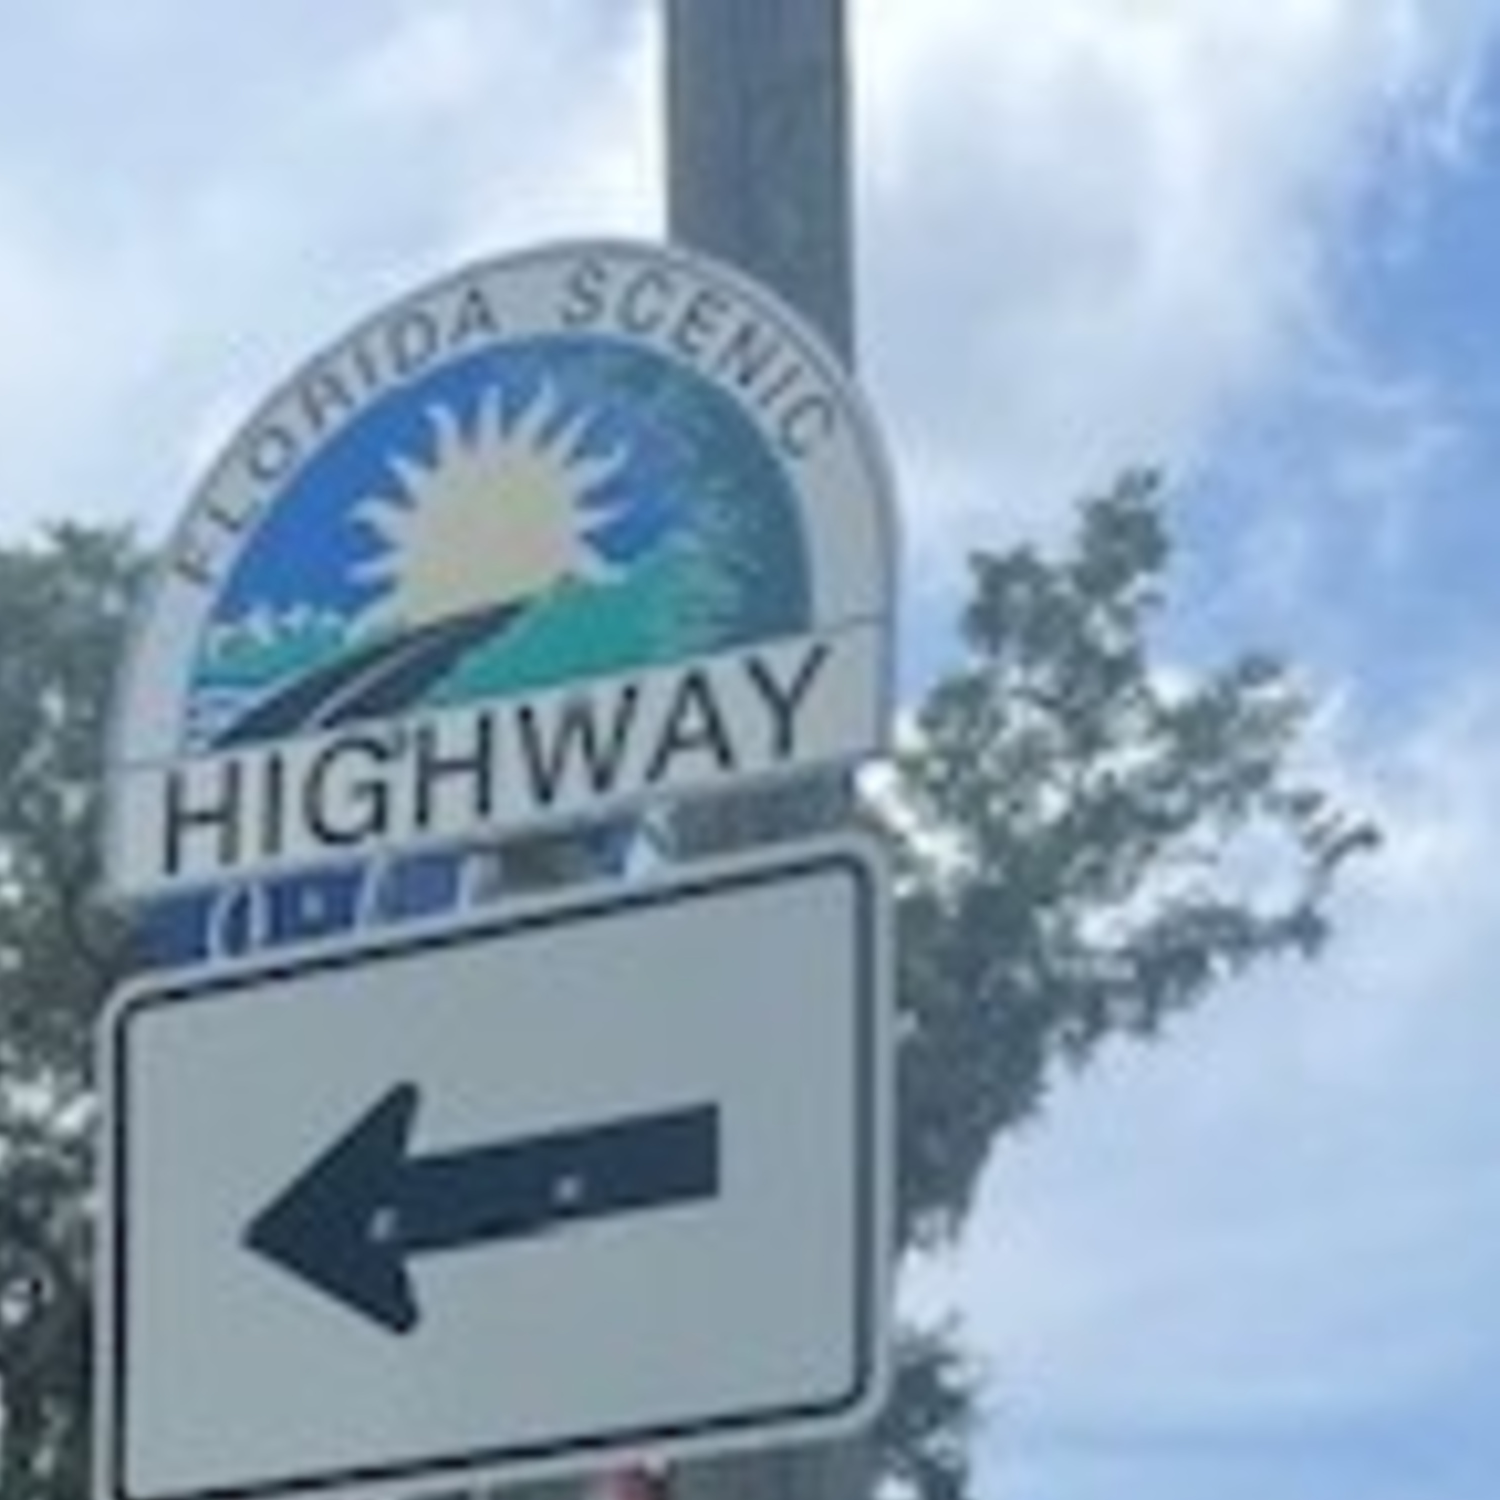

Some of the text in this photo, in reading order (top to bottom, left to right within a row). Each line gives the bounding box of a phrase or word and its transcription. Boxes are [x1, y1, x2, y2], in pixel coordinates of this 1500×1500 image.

[175, 260, 834, 585] FLORIDA SCENIC
[163, 644, 831, 876] HIGHWAY
